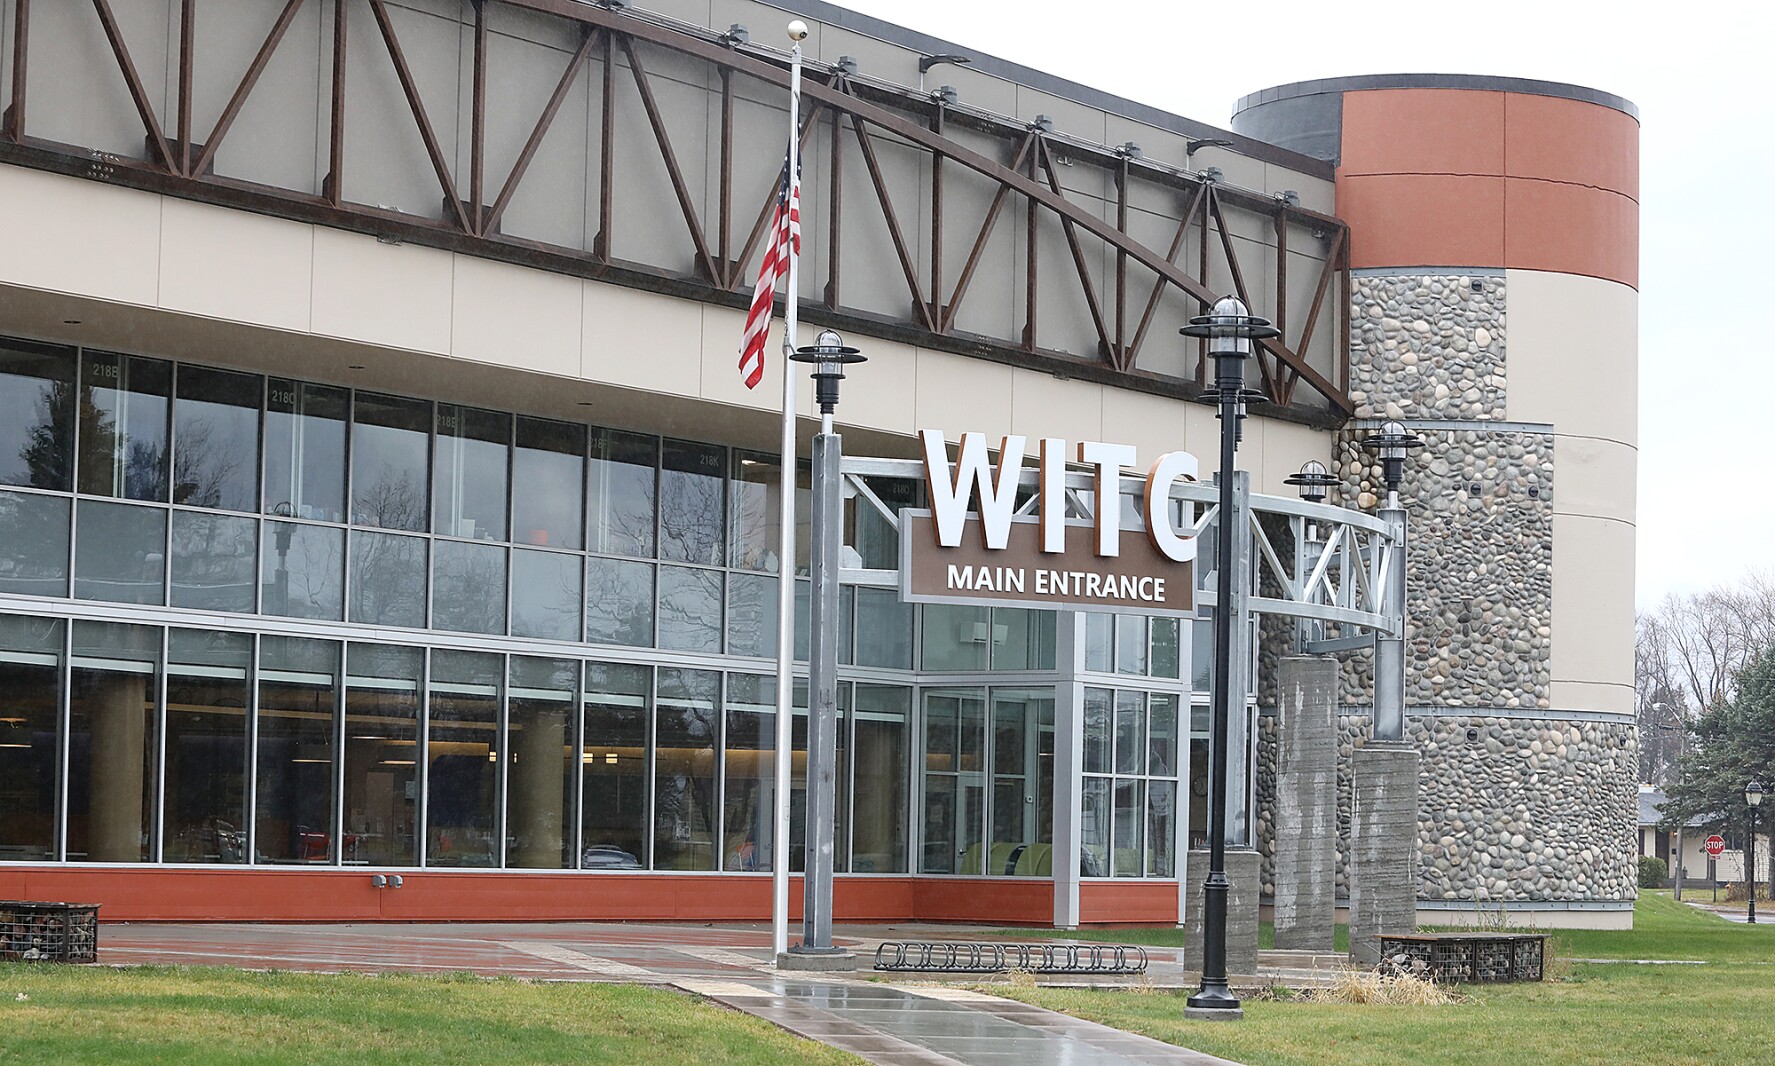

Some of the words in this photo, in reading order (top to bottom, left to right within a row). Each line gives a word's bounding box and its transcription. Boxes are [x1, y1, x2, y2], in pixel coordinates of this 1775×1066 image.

[93, 363, 118, 378] 218B
[272, 389, 295, 405] 218C
[700, 454, 719, 467] 218K
[918, 429, 1199, 562] WITC
[947, 564, 1025, 593] MAIN
[1035, 569, 1165, 602] ENTRANCE
[1706, 841, 1724, 849] STOP
